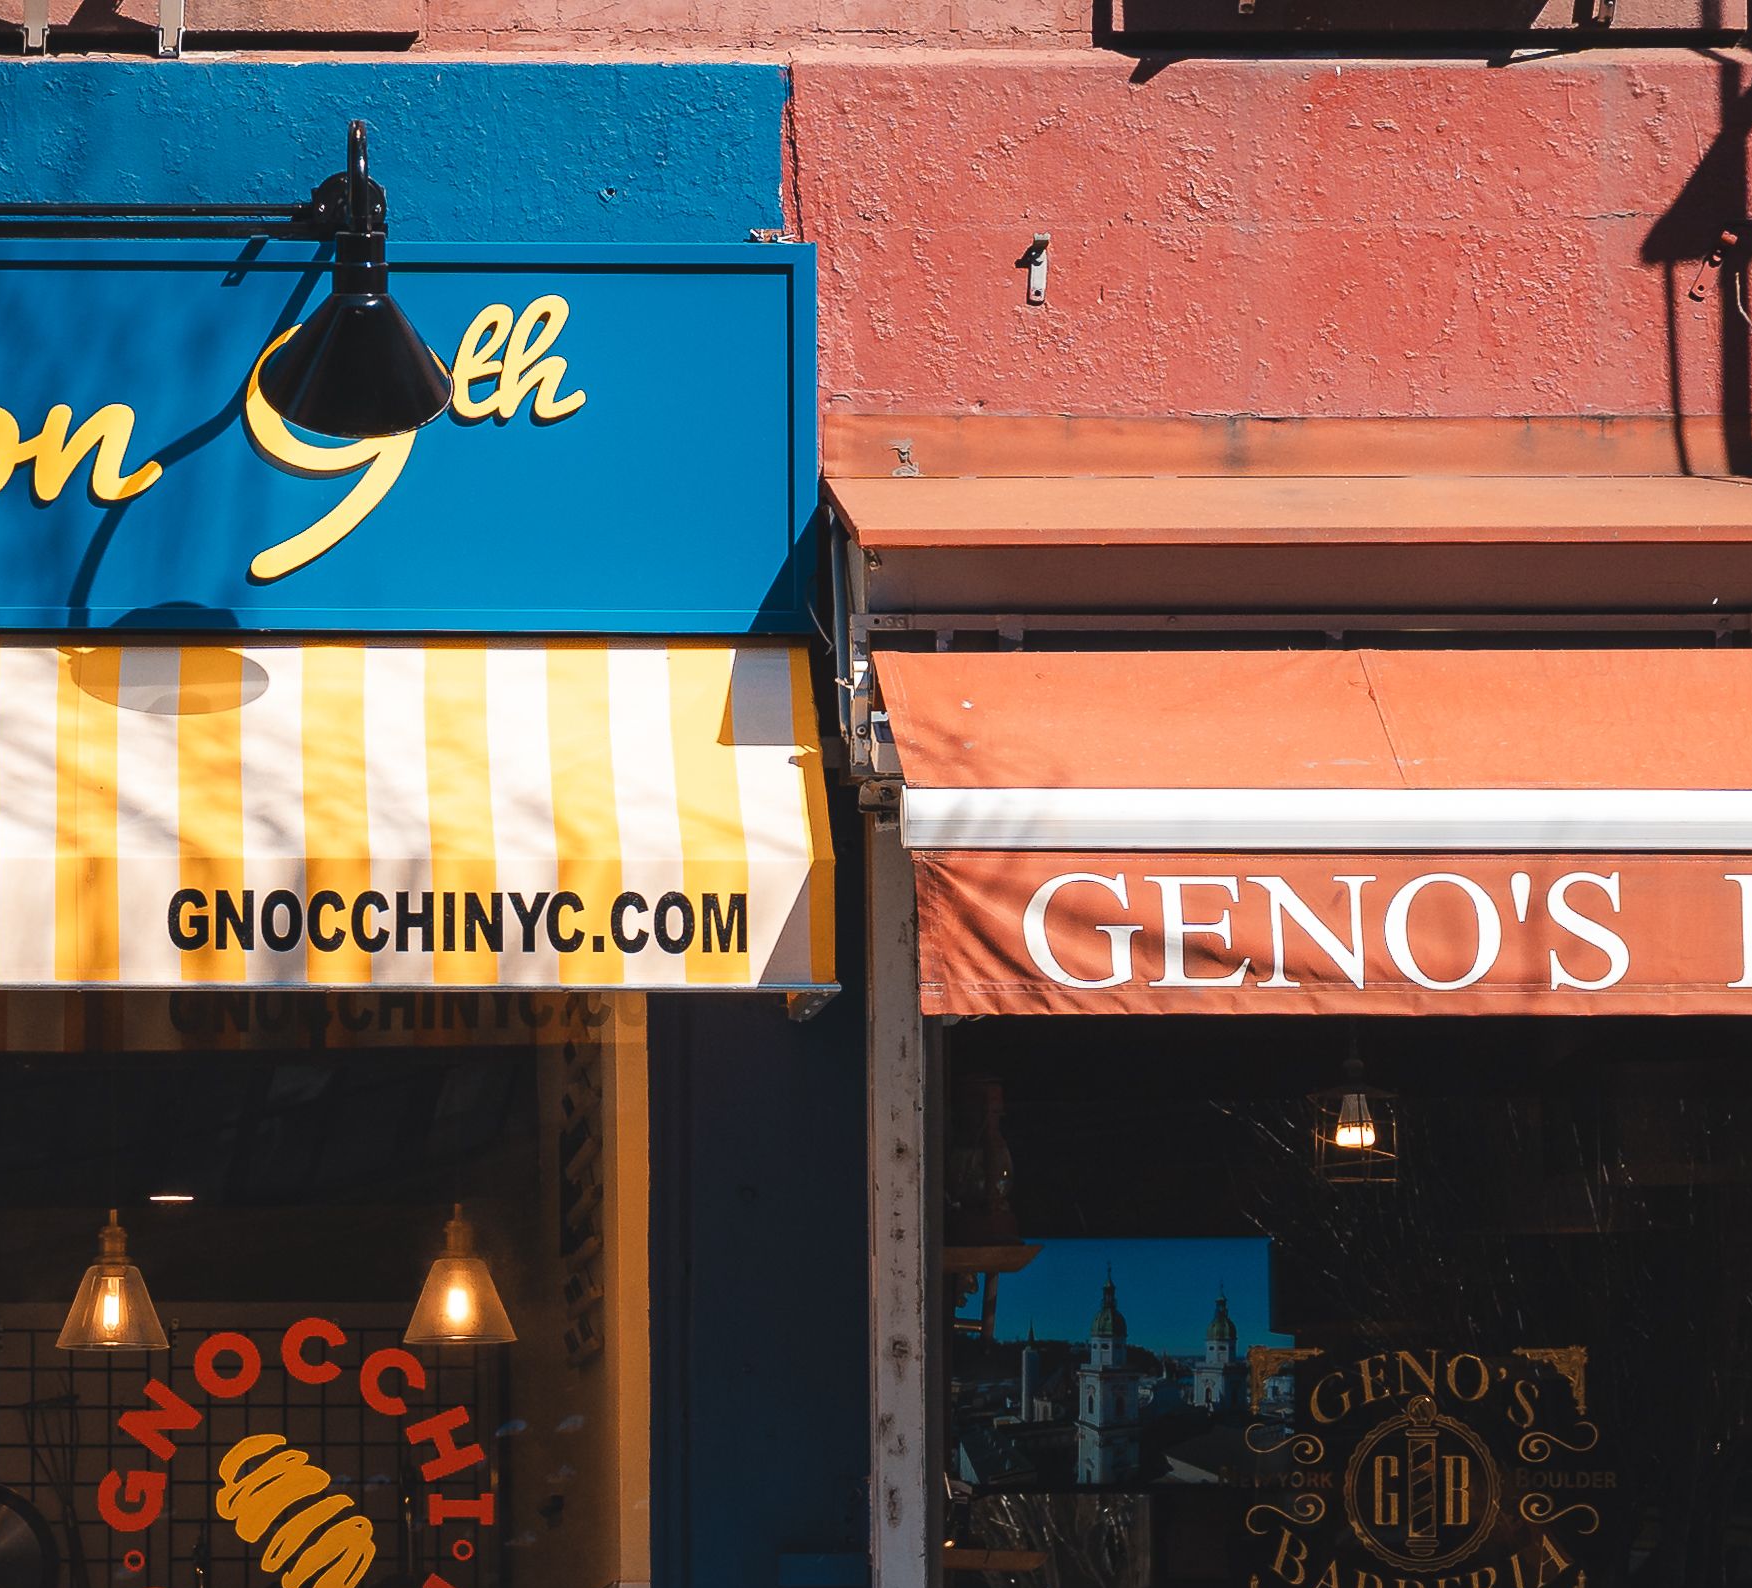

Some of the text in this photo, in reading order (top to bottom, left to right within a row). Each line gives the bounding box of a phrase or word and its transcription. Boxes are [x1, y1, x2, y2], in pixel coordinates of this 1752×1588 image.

[167, 887, 748, 955] GNOCCHINYC.COM
[1021, 870, 1631, 991] GENO'S
[97, 1316, 495, 1532] GNOCCHI
[1310, 1347, 1540, 1429] GENO'S
